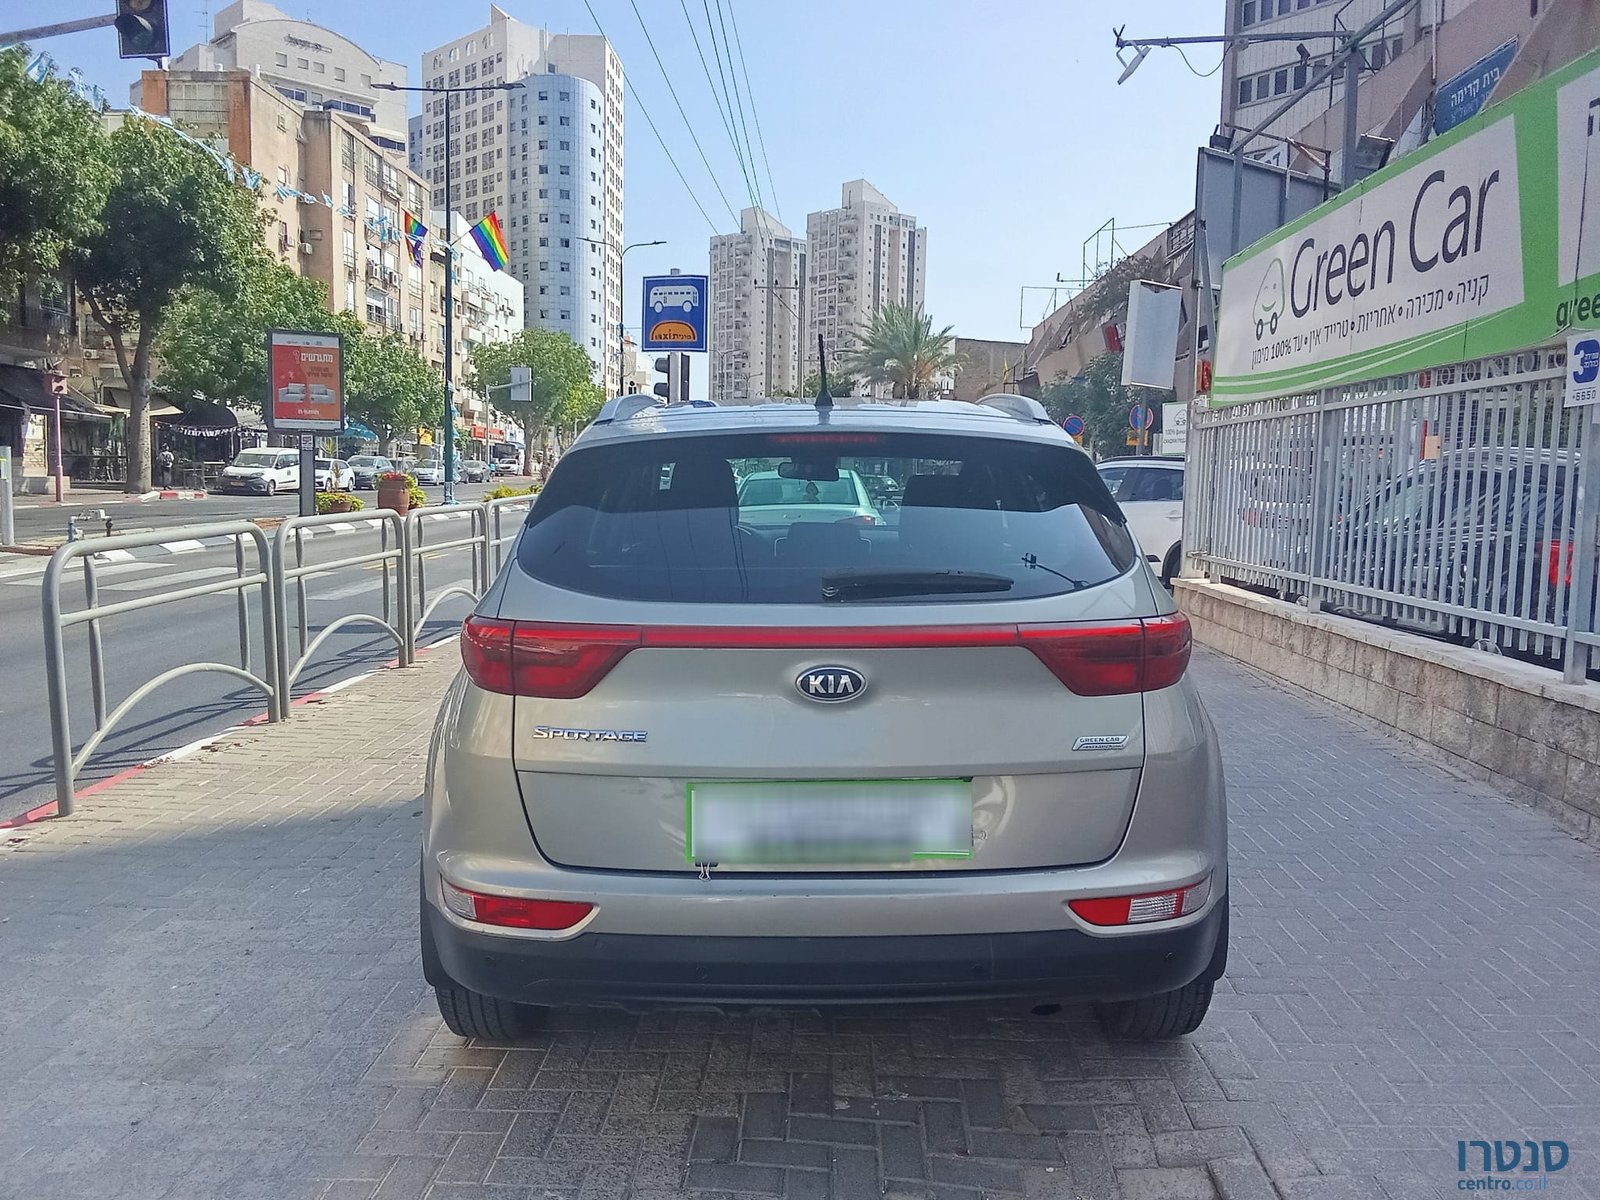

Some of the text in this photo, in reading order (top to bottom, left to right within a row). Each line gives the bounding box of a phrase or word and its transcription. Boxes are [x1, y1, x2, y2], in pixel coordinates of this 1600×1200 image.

[1482, 67, 1500, 88] בית
[1451, 78, 1480, 107] קדימה
[1290, 169, 1500, 318] Green Car
[1405, 288, 1444, 318] מכירה
[1455, 274, 1490, 306] קניה
[1356, 303, 1397, 334] אחריות
[1251, 345, 1270, 369] מימון
[1270, 338, 1292, 359] 100%
[808, 674, 855, 694] KIA
[533, 726, 648, 742] SPORTAGE
